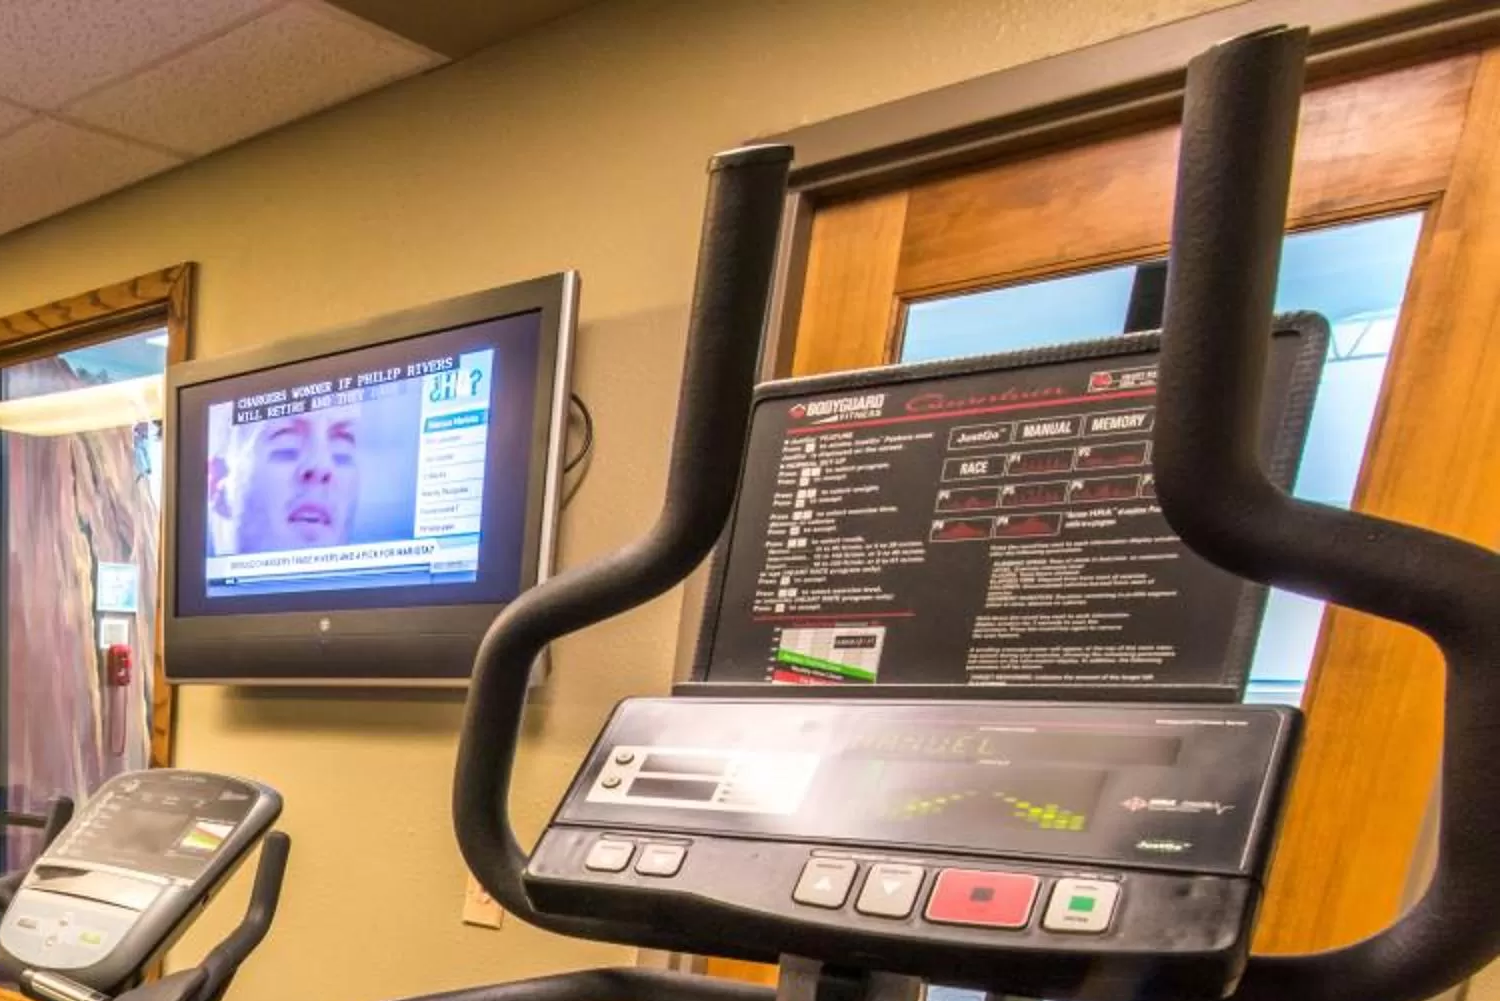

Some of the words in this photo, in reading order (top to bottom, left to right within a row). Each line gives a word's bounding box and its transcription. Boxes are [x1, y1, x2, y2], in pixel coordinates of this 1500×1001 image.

[292, 380, 333, 400] WONDER
[337, 376, 353, 390] IF
[357, 366, 401, 387] PHILIP
[407, 356, 454, 377] RIVERS
[806, 393, 886, 418] BODYGUARD
[837, 409, 883, 422] FITNESS
[237, 408, 263, 424] WILL
[1023, 420, 1073, 438] MANUAL
[1091, 413, 1147, 432] MEMORY
[960, 461, 989, 475] RACE
